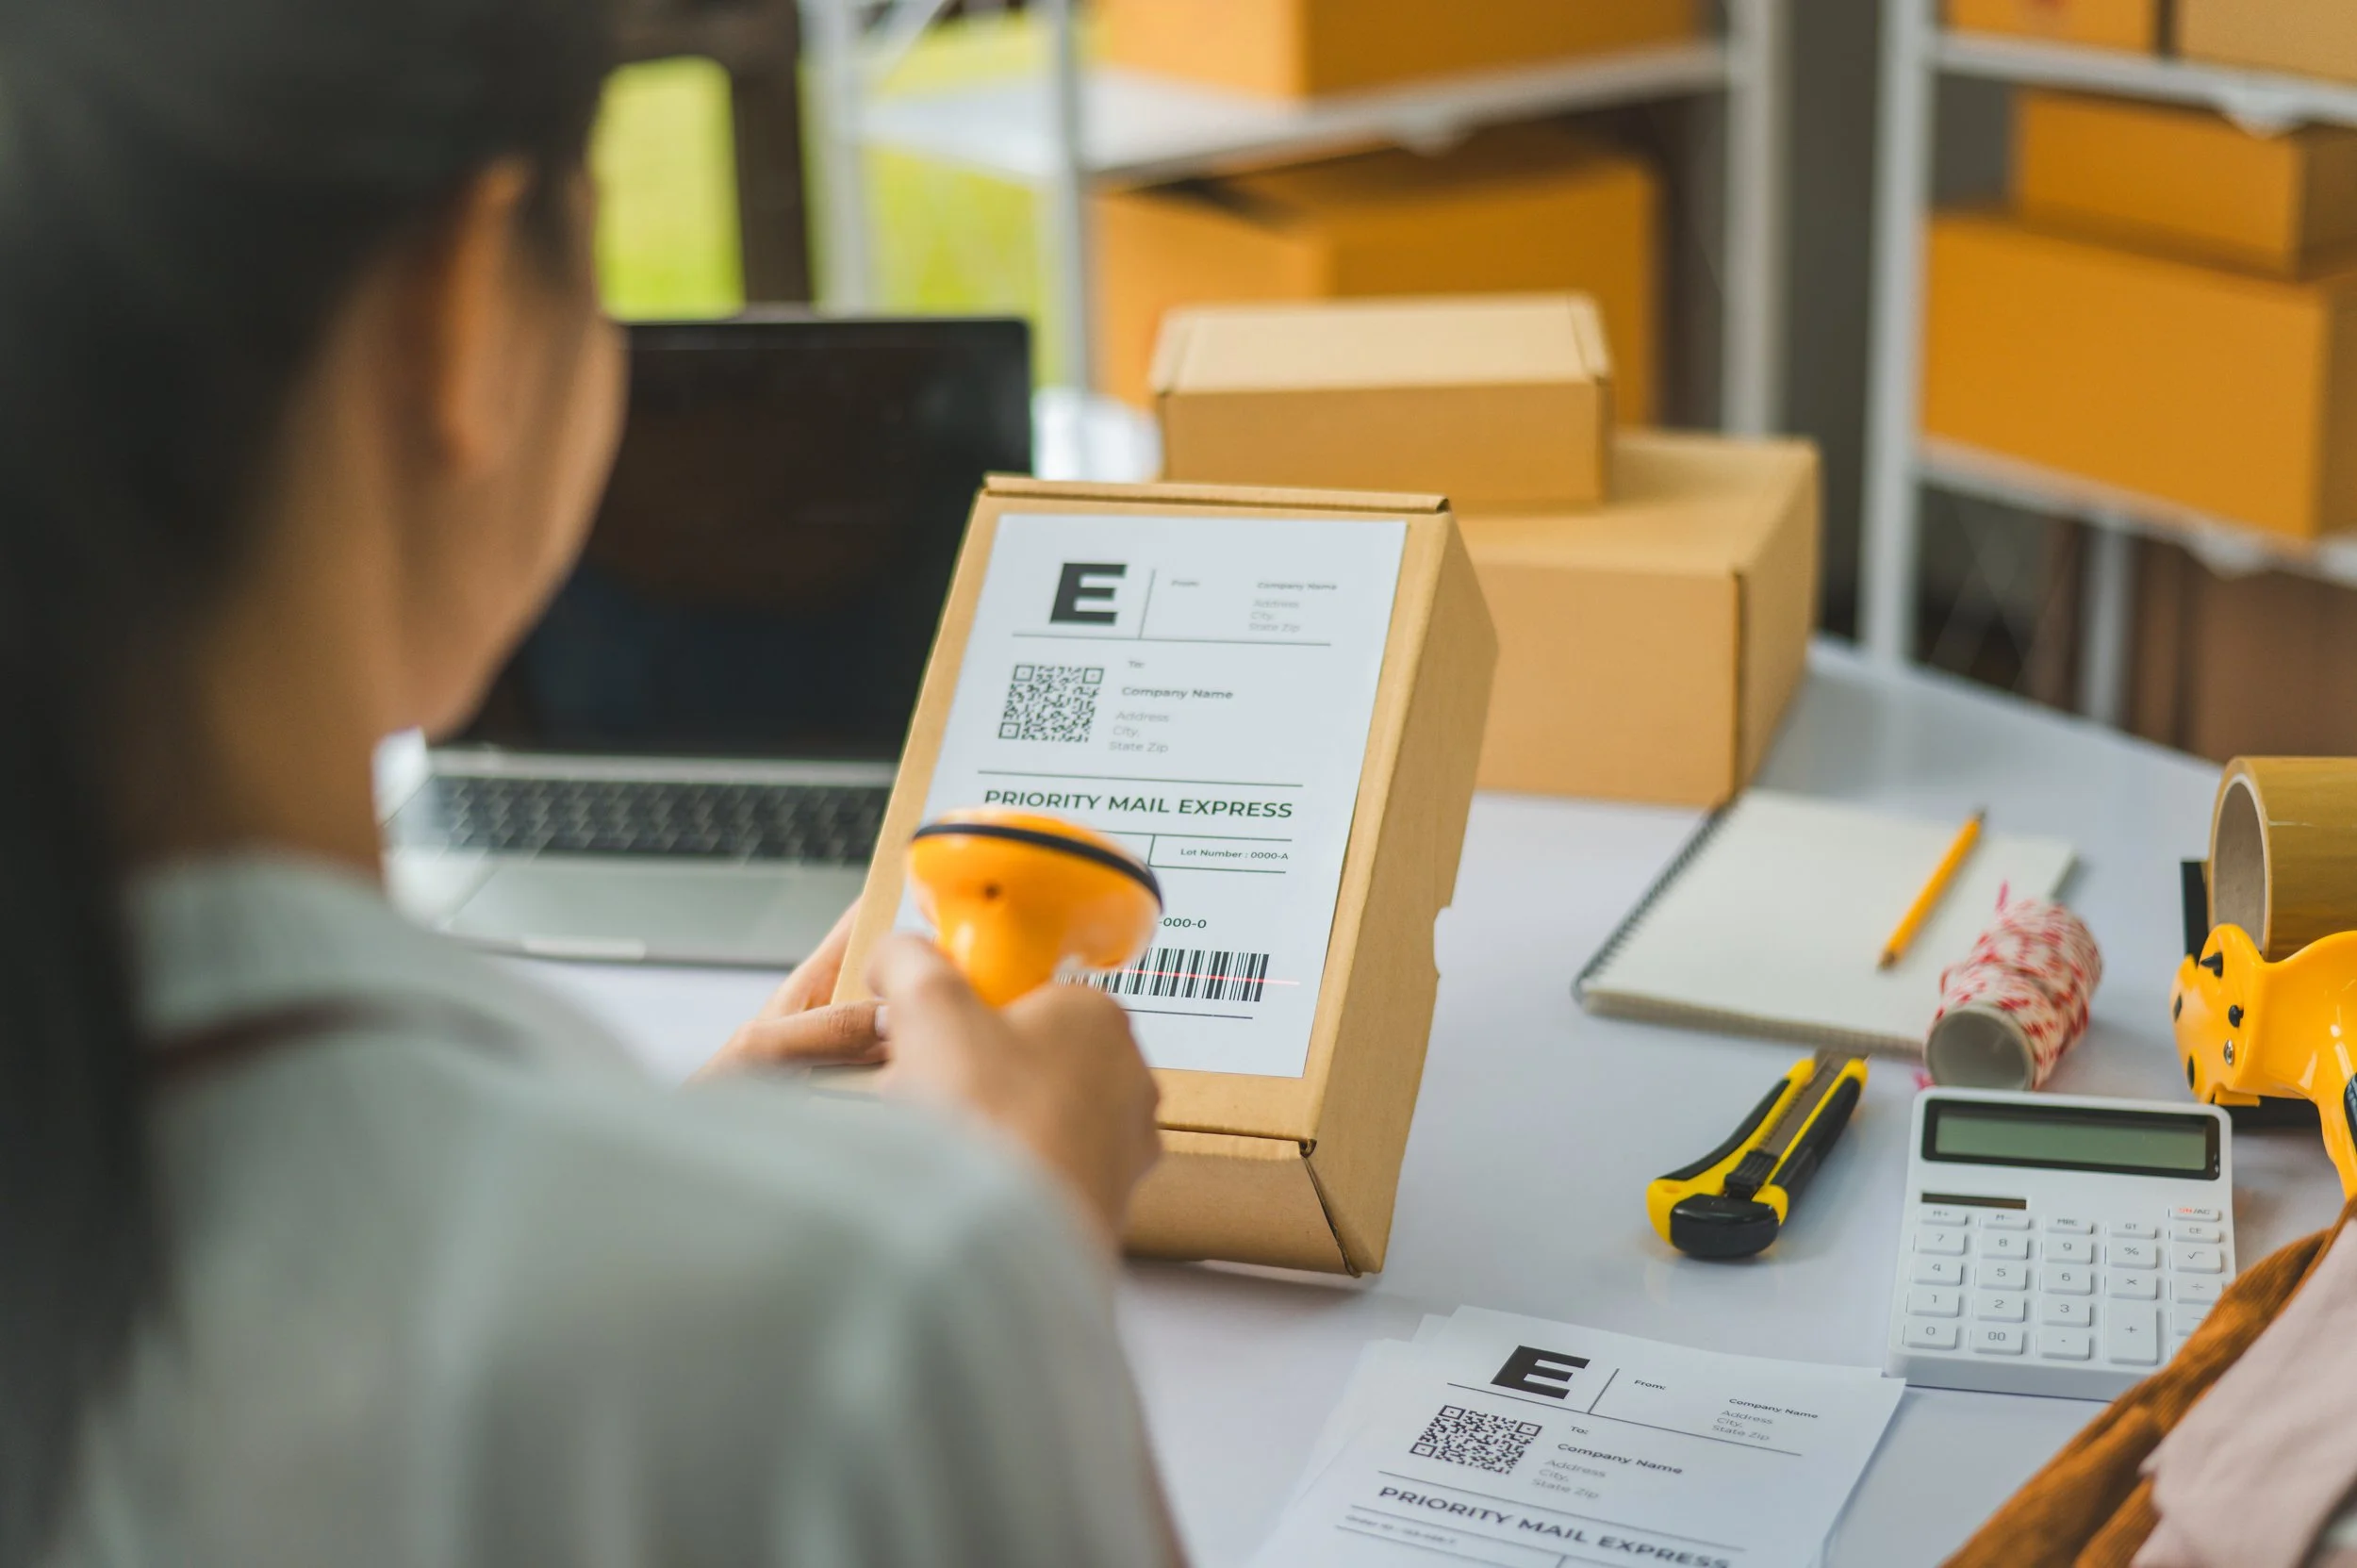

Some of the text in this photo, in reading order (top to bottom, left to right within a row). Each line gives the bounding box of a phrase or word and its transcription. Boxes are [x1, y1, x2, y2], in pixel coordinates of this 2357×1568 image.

[1257, 581, 1338, 591] Company Name
[1049, 563, 1128, 625] E
[1252, 599, 1300, 609] Address
[1247, 622, 1301, 634] State Zip
[1122, 686, 1233, 701] Company Name
[1115, 711, 1170, 723] Address
[1113, 726, 1140, 738] City,
[1109, 740, 1169, 754] State Zip
[984, 789, 1293, 818] PRIORITY MAIL EXPRESS
[1180, 849, 1196, 857] Lot
[1199, 849, 1242, 859] Number
[1250, 850, 1289, 860] 0000-A
[1937, 1233, 1945, 1242] 7
[1998, 1238, 2008, 1247] 8
[2062, 1242, 2072, 1251] 9
[1932, 1263, 1941, 1272] 4
[1996, 1267, 2006, 1278] 5
[2061, 1272, 2071, 1281] 6
[1932, 1294, 1937, 1304] 1
[1994, 1298, 2004, 1309] 2
[2059, 1304, 2069, 1313] 3
[1925, 1326, 1936, 1336] 0
[1987, 1331, 2006, 1341] 00
[1491, 1345, 1591, 1400] E
[1634, 1378, 1666, 1391] From:
[1729, 1397, 1819, 1419] Company Name
[1721, 1410, 1773, 1426] Address
[1570, 1425, 1590, 1435] To:
[1712, 1425, 1770, 1442] State Zip
[1558, 1443, 1683, 1475] Company Name
[1544, 1460, 1606, 1478] Address
[1532, 1477, 1600, 1499] State Zip
[1378, 1486, 1732, 1568] PRIORITY MAIL EXPRESS
